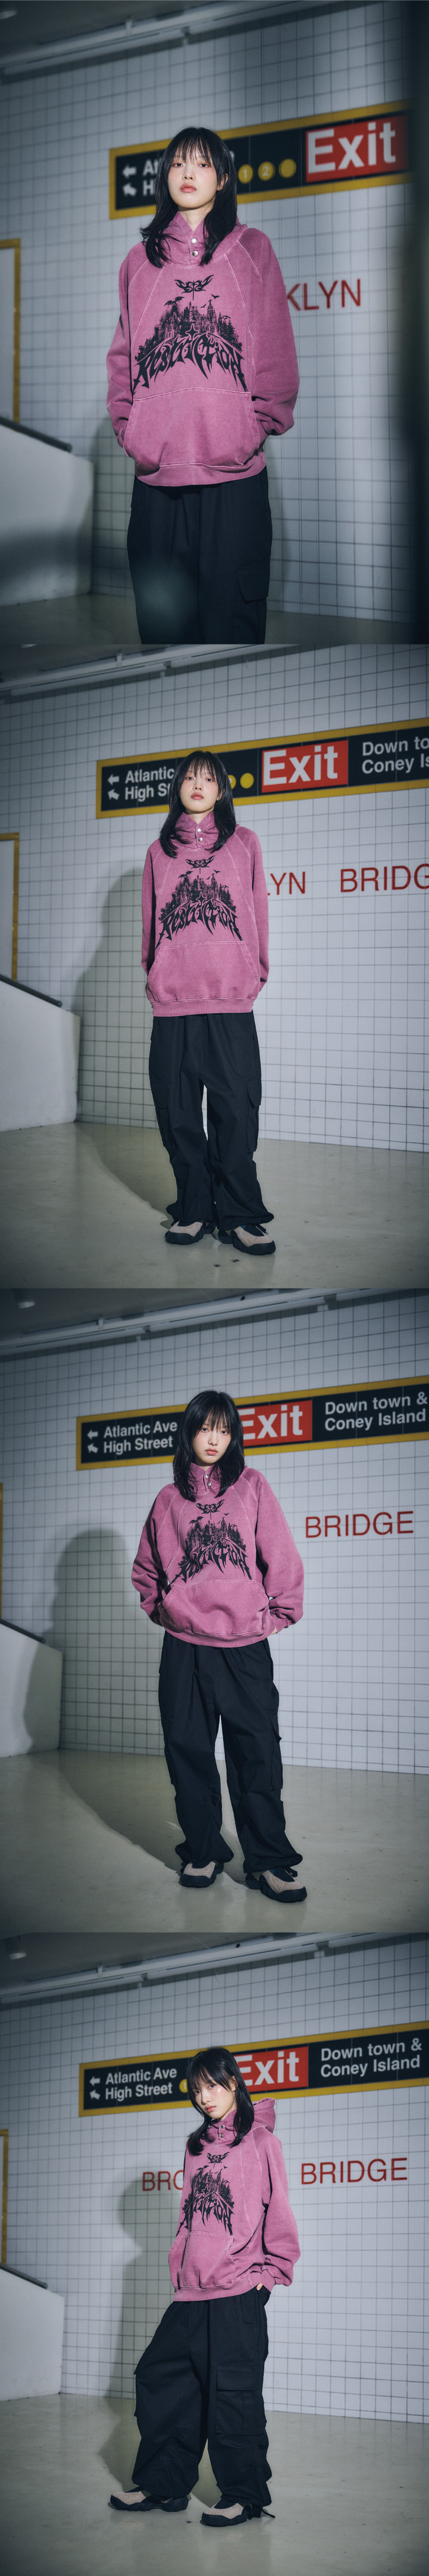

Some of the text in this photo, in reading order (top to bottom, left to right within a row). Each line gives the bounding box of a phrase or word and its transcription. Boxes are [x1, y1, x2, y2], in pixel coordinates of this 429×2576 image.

[308, 122, 396, 173] Exit
[362, 741, 408, 756] Down
[125, 766, 175, 784] Atlantic
[263, 745, 338, 786] Exit
[362, 757, 414, 774] Coney
[125, 785, 154, 802] High
[268, 871, 305, 896] YN
[325, 1401, 367, 1415] Down
[372, 1396, 411, 1410] town
[104, 1421, 177, 1438] Atlantic Ave
[237, 1404, 303, 1440] Exit
[325, 1408, 426, 1431] Coney Island
[104, 1435, 173, 1455] High Street
[305, 1511, 414, 1538] BRIDGE
[321, 2048, 363, 2061] Down
[367, 2042, 406, 2056] town
[105, 2067, 177, 2085] Atlantic Ave
[234, 2051, 299, 2086] Exit
[320, 2055, 420, 2077] Coney Island
[105, 2082, 173, 2102] High Street
[301, 2158, 408, 2185] BRIDGE
